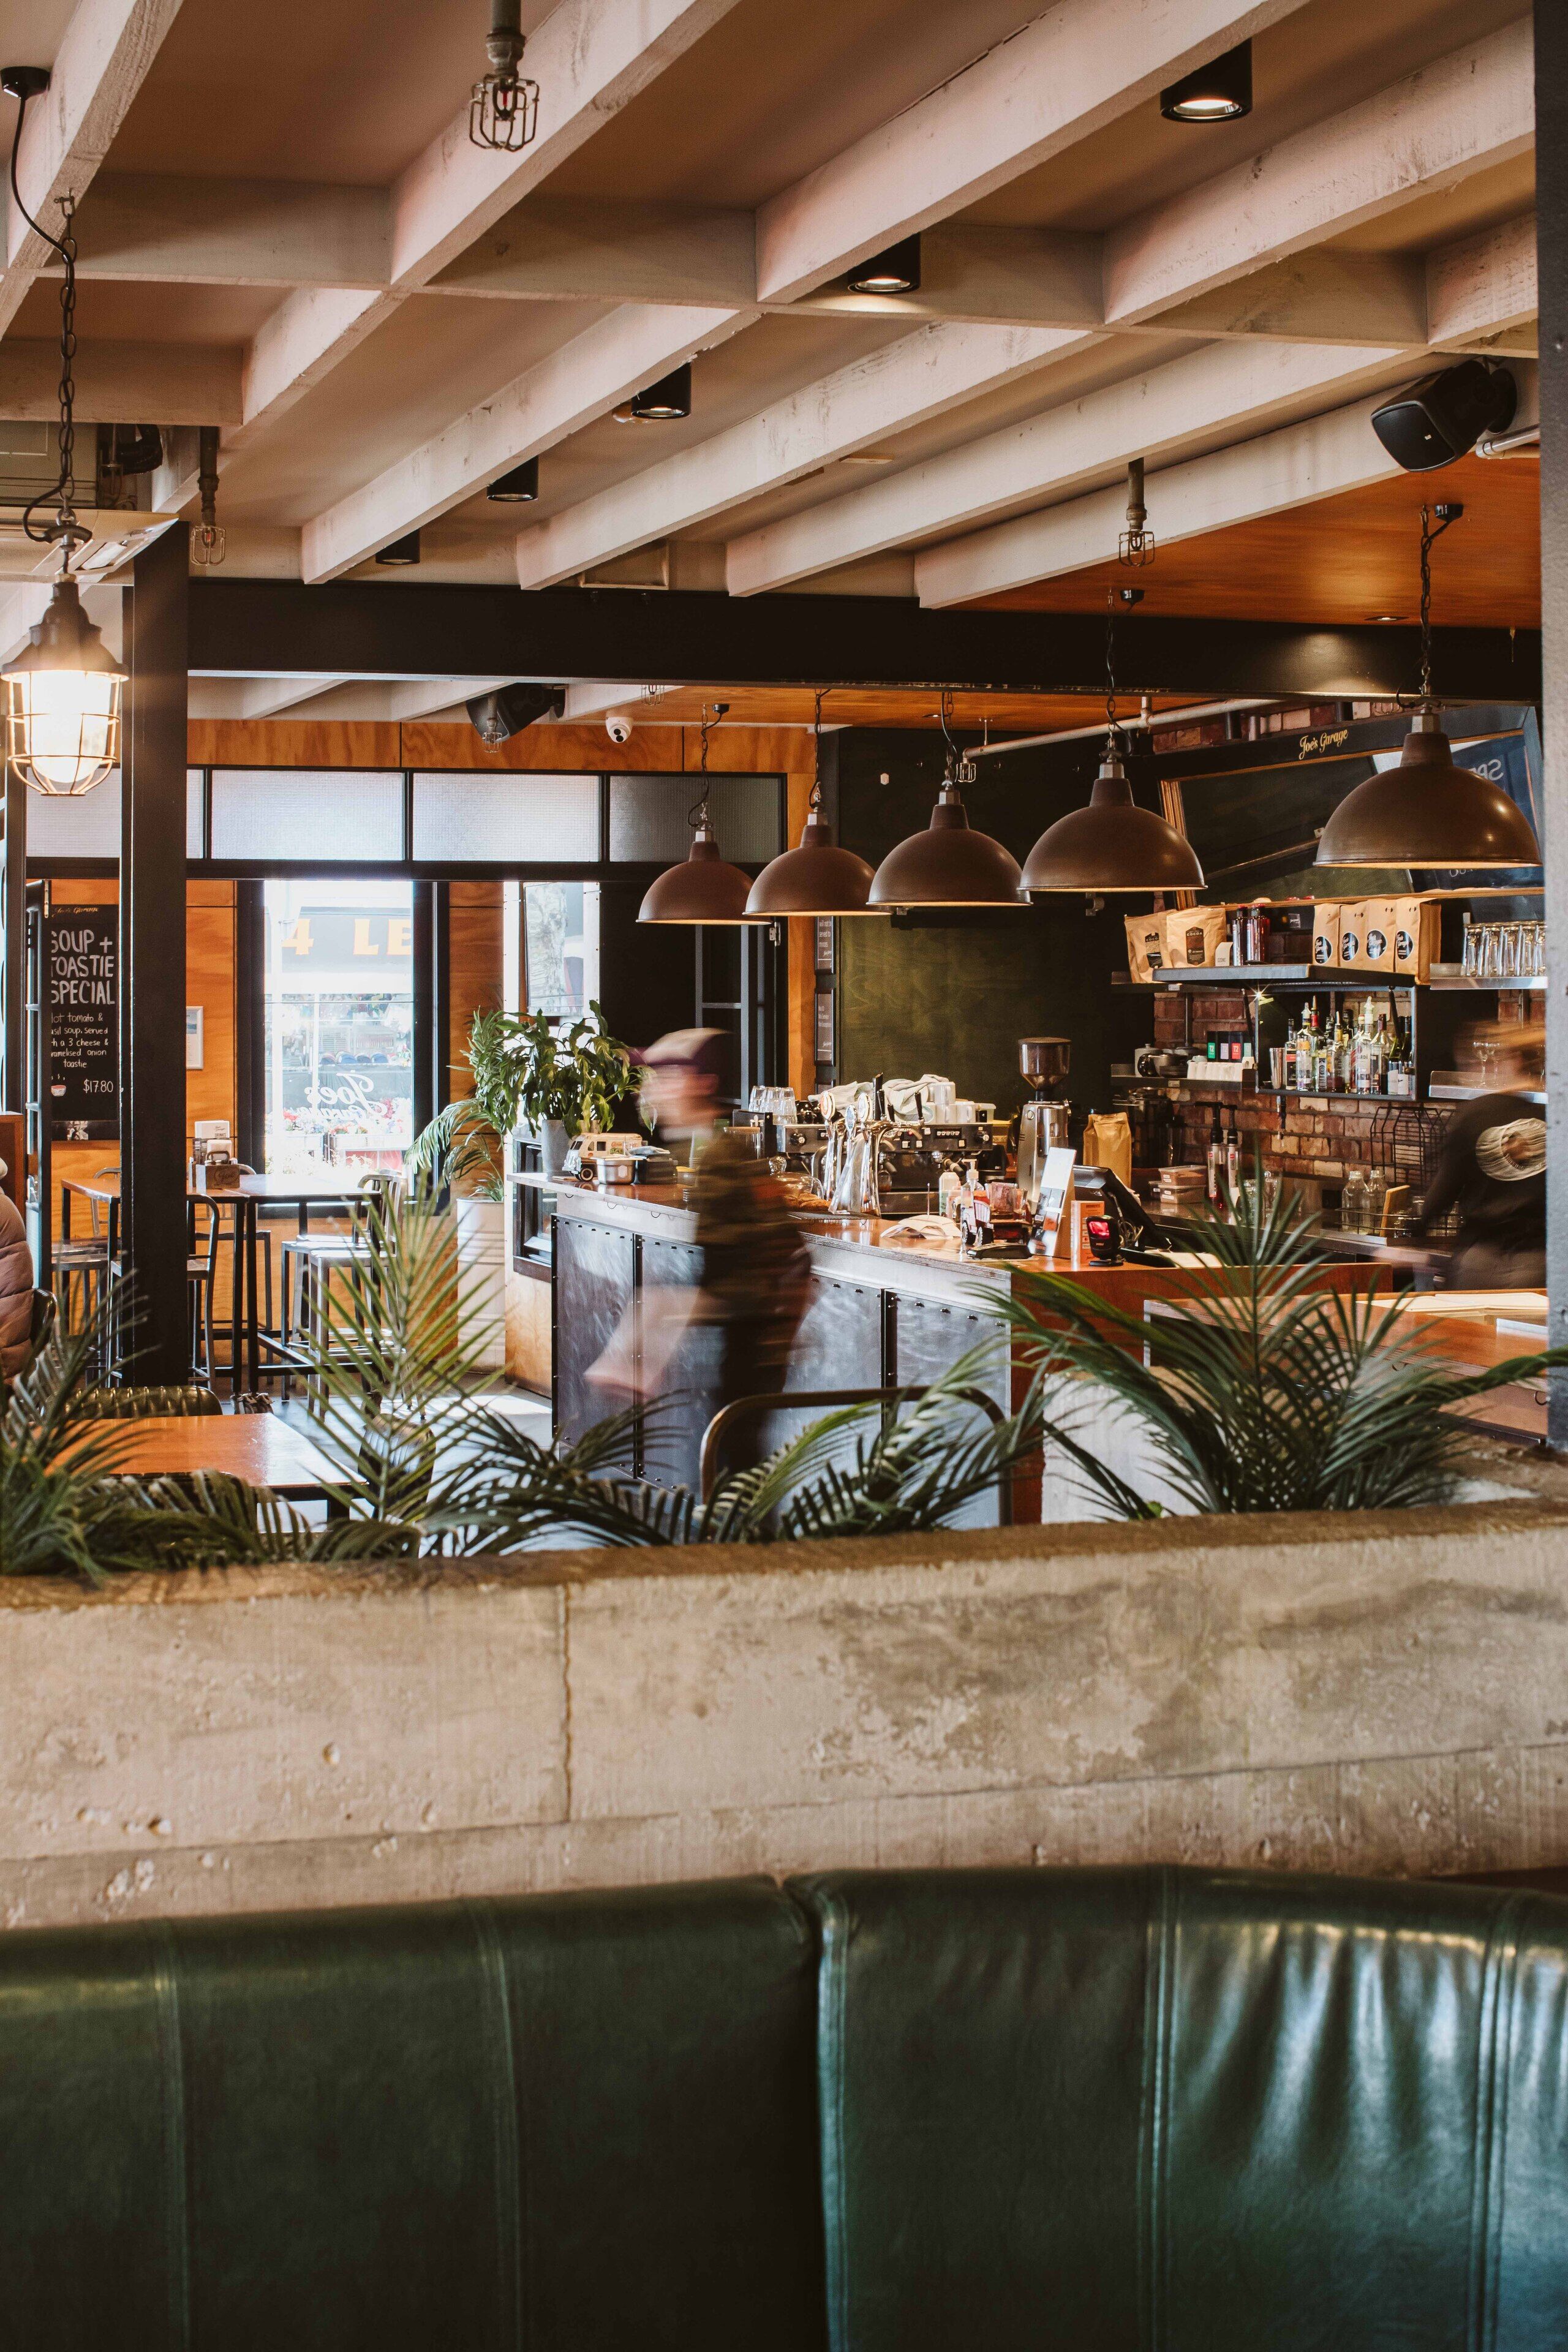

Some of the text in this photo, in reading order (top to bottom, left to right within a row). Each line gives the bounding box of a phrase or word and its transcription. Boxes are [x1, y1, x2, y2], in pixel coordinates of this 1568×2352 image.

[1298, 729, 1349, 760] Joe's Garage
[67, 1012, 94, 1023] tomato
[98, 1012, 103, 1022] &
[69, 1038, 74, 1047] 3
[63, 1058, 88, 1068] toastie
